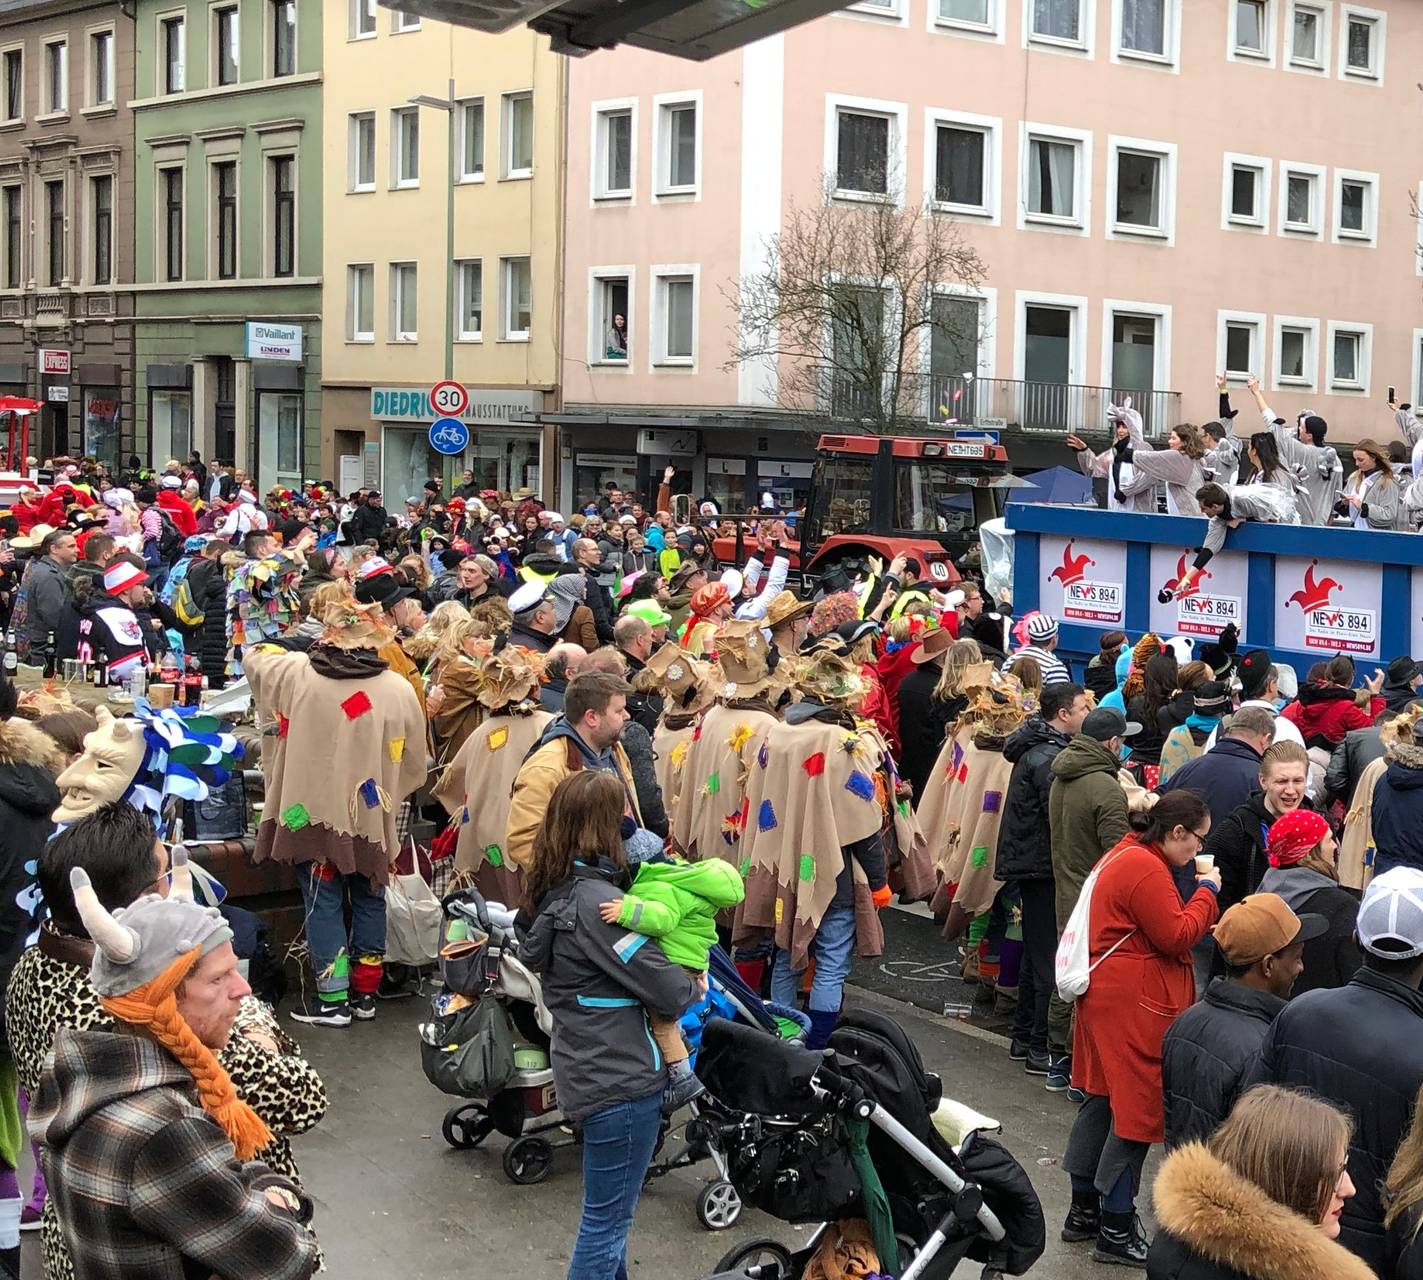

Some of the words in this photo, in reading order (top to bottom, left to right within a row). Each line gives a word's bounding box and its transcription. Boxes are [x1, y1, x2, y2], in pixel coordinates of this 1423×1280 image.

[264, 328, 296, 340] Vaillant
[45, 355, 68, 369] EXPRESS
[438, 390, 460, 407] 30
[933, 563, 946, 577] 40
[1070, 584, 1097, 600] NEWS
[1099, 588, 1116, 602] 89.4
[1184, 598, 1213, 614] NEWS
[1216, 601, 1234, 616] 89.4
[1313, 611, 1344, 628] NEWS
[1347, 615, 1368, 630] 89.4
